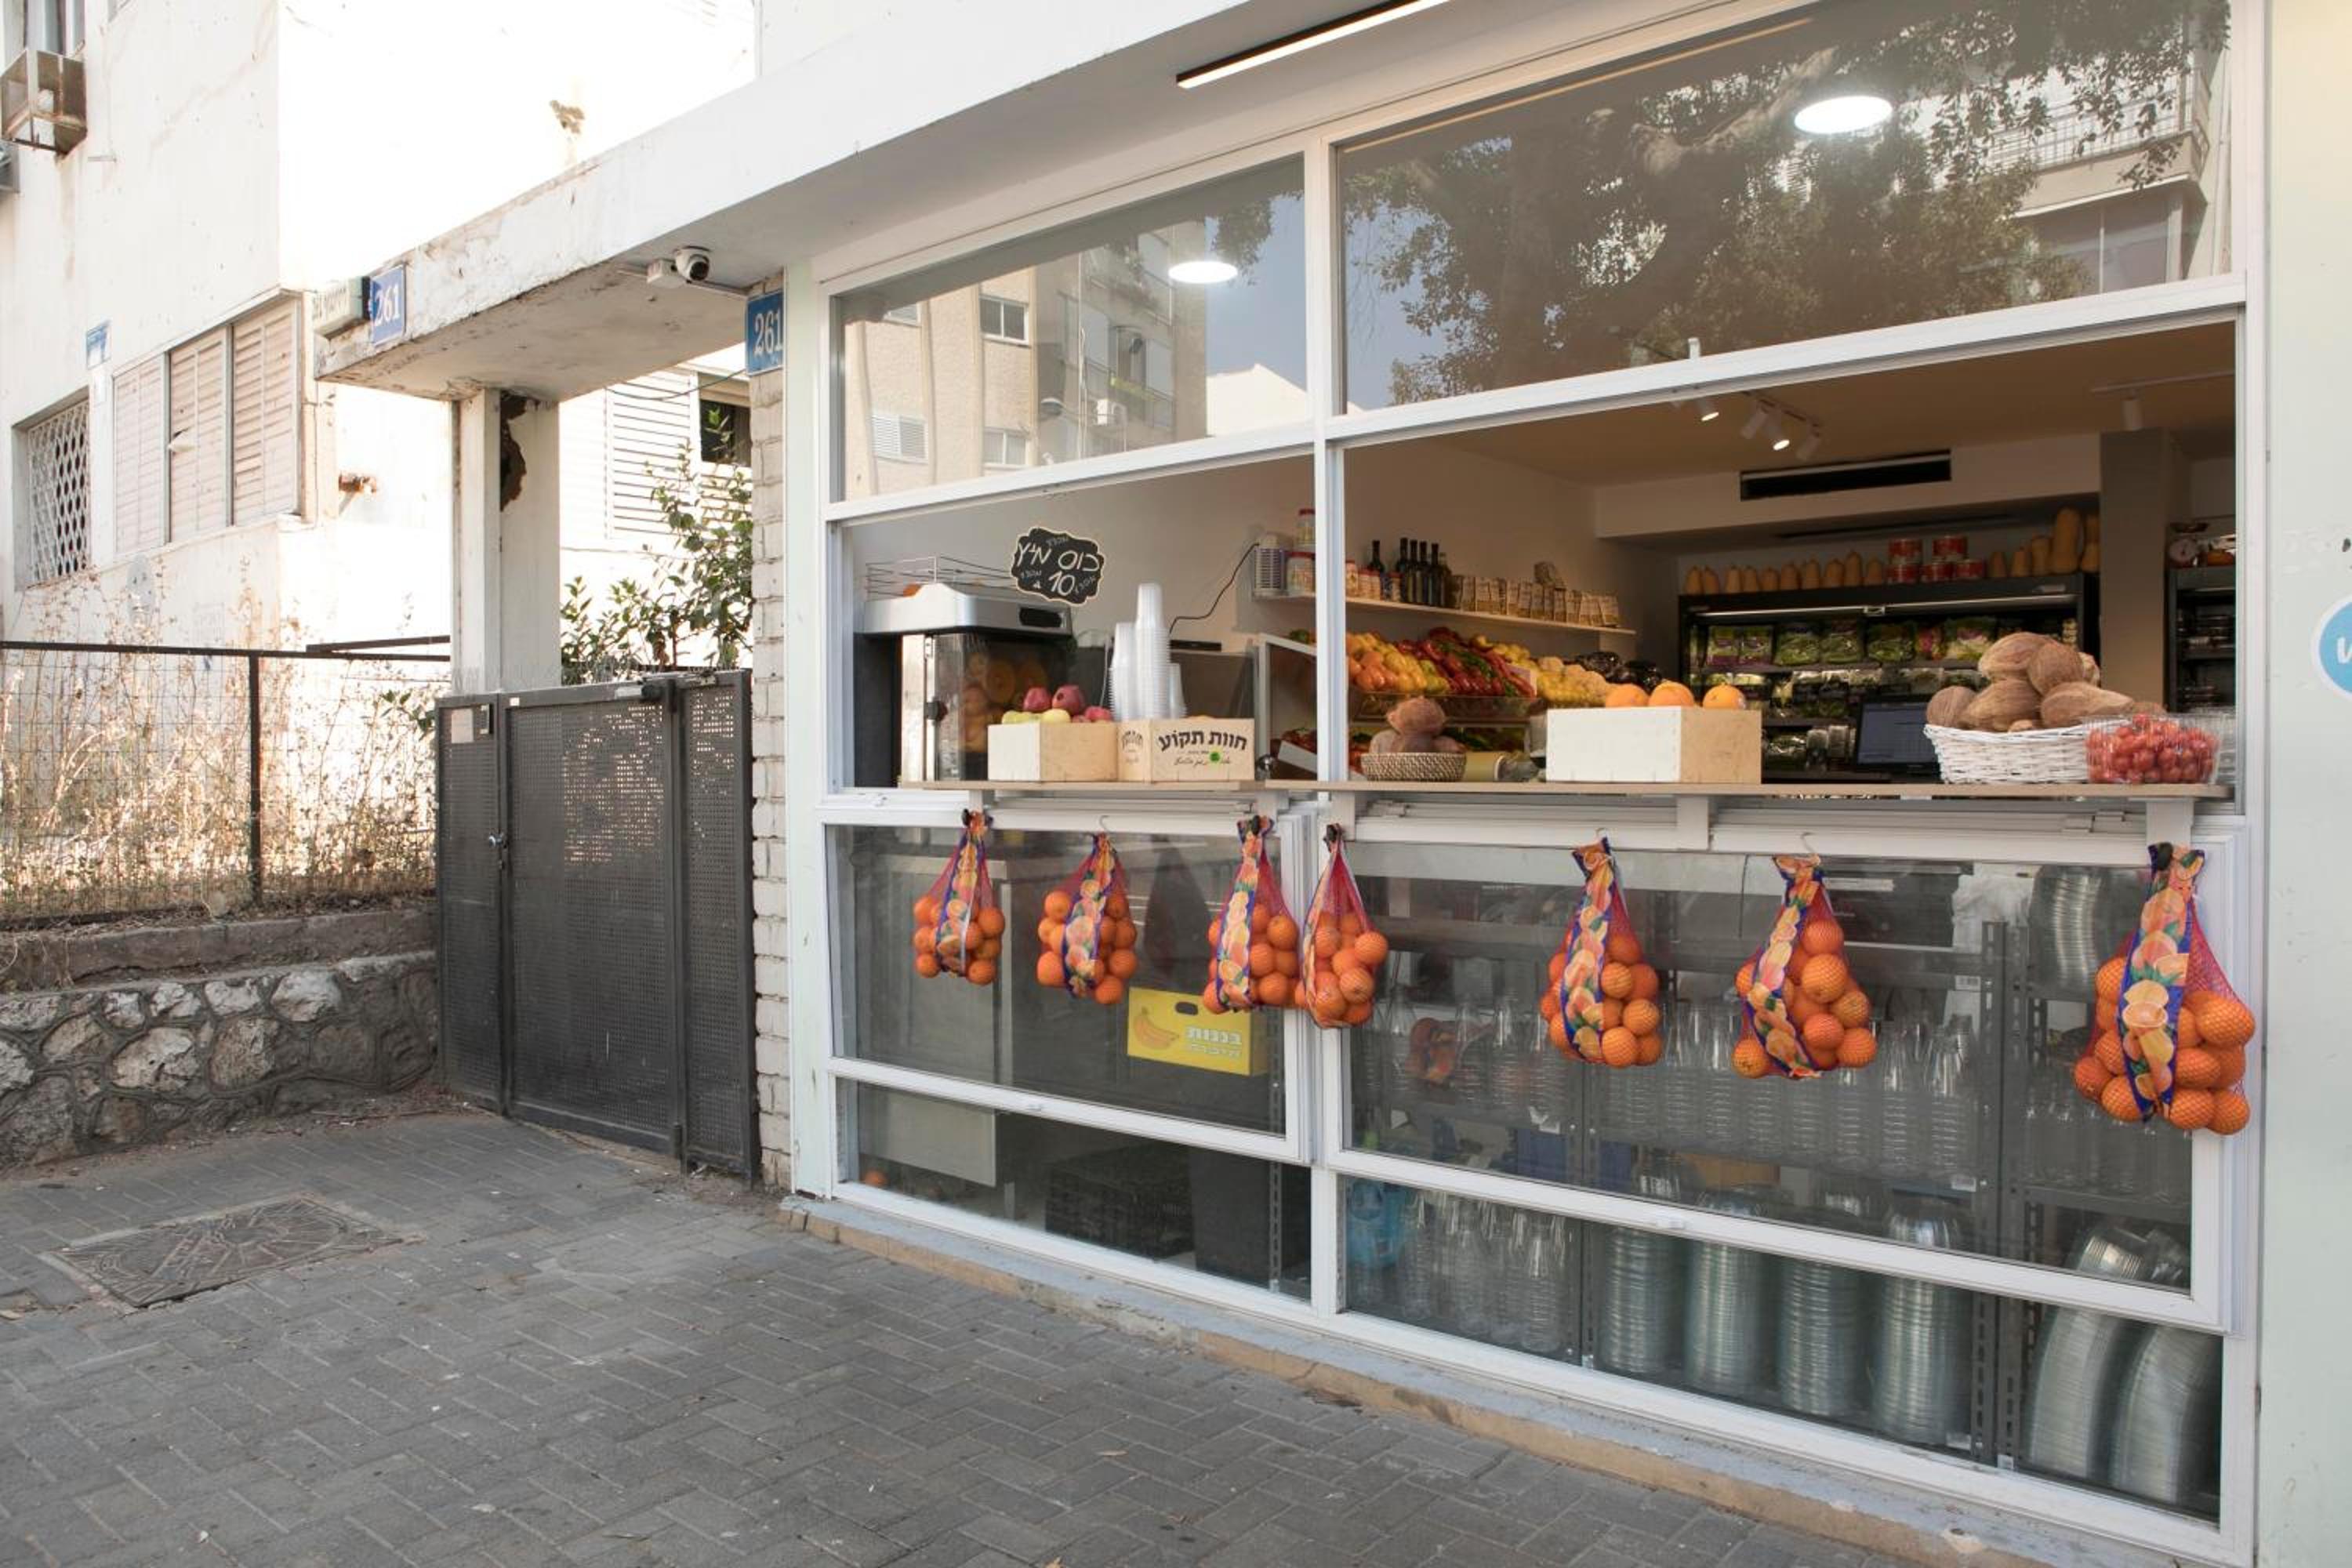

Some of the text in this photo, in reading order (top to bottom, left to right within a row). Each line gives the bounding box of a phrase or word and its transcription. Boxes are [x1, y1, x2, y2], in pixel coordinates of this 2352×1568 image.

[374, 283, 400, 327] 261
[753, 307, 784, 357] 261
[1016, 542, 1052, 568] מיץ
[1058, 550, 1100, 572] כוס
[1048, 571, 1076, 596] 10
[1208, 730, 1248, 750] חוות
